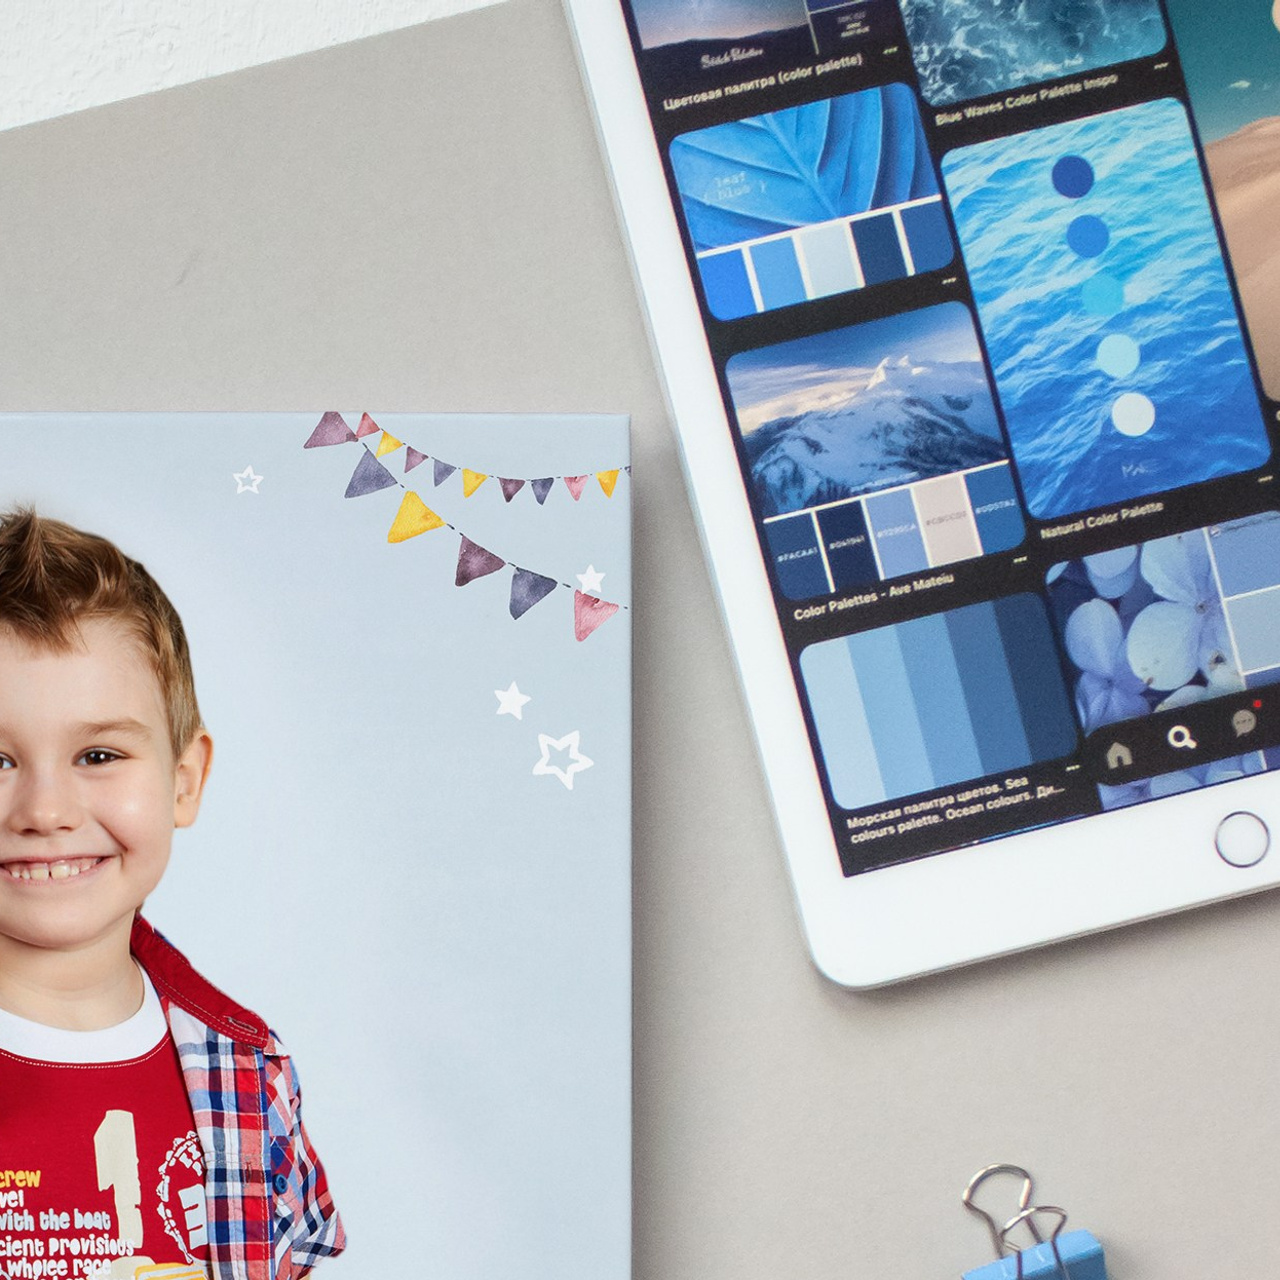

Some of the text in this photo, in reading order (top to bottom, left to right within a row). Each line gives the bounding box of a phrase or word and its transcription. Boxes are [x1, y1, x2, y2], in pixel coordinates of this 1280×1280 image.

[663, 53, 864, 112] Цветовая палитра (color palette)
[935, 111, 963, 126] Blue
[964, 100, 1004, 119] Waves
[1005, 91, 1038, 109] Color
[1039, 82, 1083, 100] Palette
[1040, 501, 1165, 540] Natural Color Palette
[793, 602, 826, 621] Color
[828, 590, 879, 613] Palettes
[889, 583, 912, 599] Ave
[847, 775, 1029, 830] Морская палитра цветов. Sea
[850, 827, 896, 845] colours
[897, 815, 943, 835] palette.
[945, 804, 984, 821] Ocean
[986, 791, 1034, 811] colours.
[39, 1208, 70, 1231] the
[73, 1208, 111, 1231] boat
[72, 1258, 113, 1279] race
